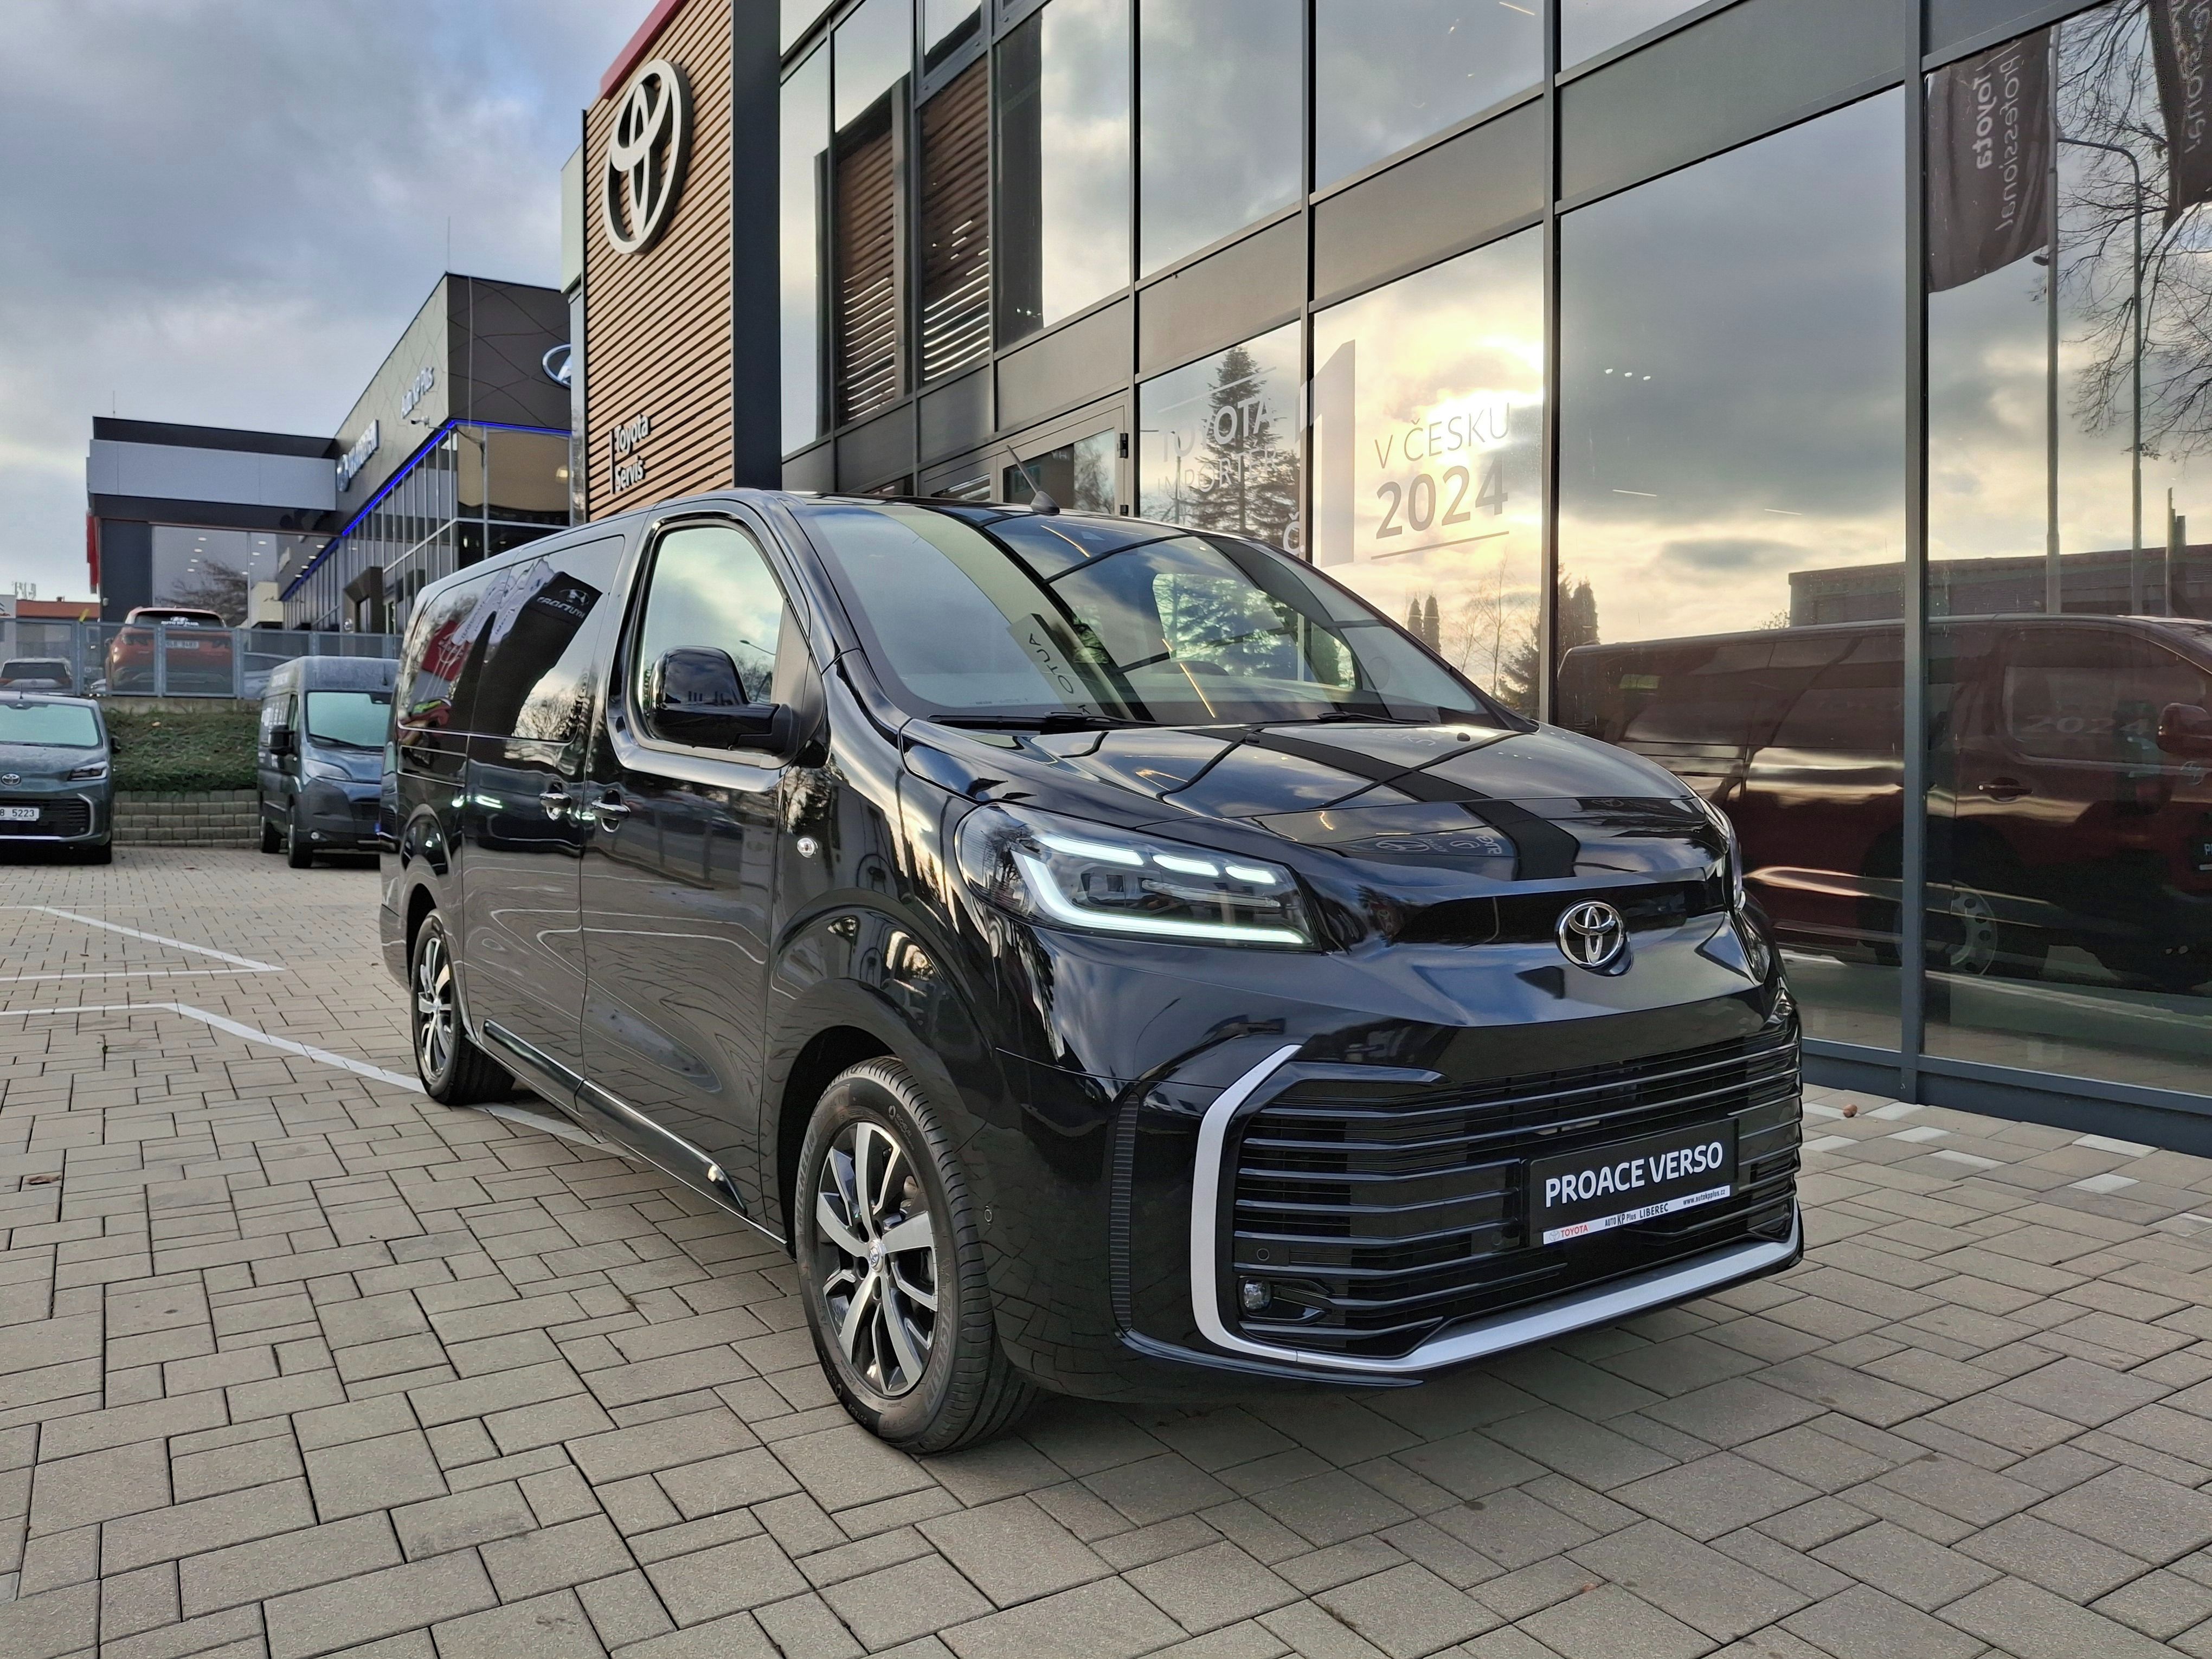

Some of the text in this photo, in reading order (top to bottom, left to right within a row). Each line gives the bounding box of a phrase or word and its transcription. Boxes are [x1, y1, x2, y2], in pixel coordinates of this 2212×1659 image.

[614, 414, 648, 455] Toyota
[1158, 396, 1274, 462] TOYOTA
[1375, 402, 1510, 470] V ČESKU
[615, 455, 644, 492] Servis
[1376, 457, 1508, 539] 2024
[12, 808, 34, 818] 5223
[1545, 1141, 1723, 1208] PROACE VERSO
[1560, 1224, 1589, 1238] TOYOTA
[1605, 1218, 1617, 1227] AUTO
[1617, 1213, 1625, 1226] KP
[1626, 1213, 1637, 1223] Plus
[1639, 1203, 1669, 1219] LIBEREC
